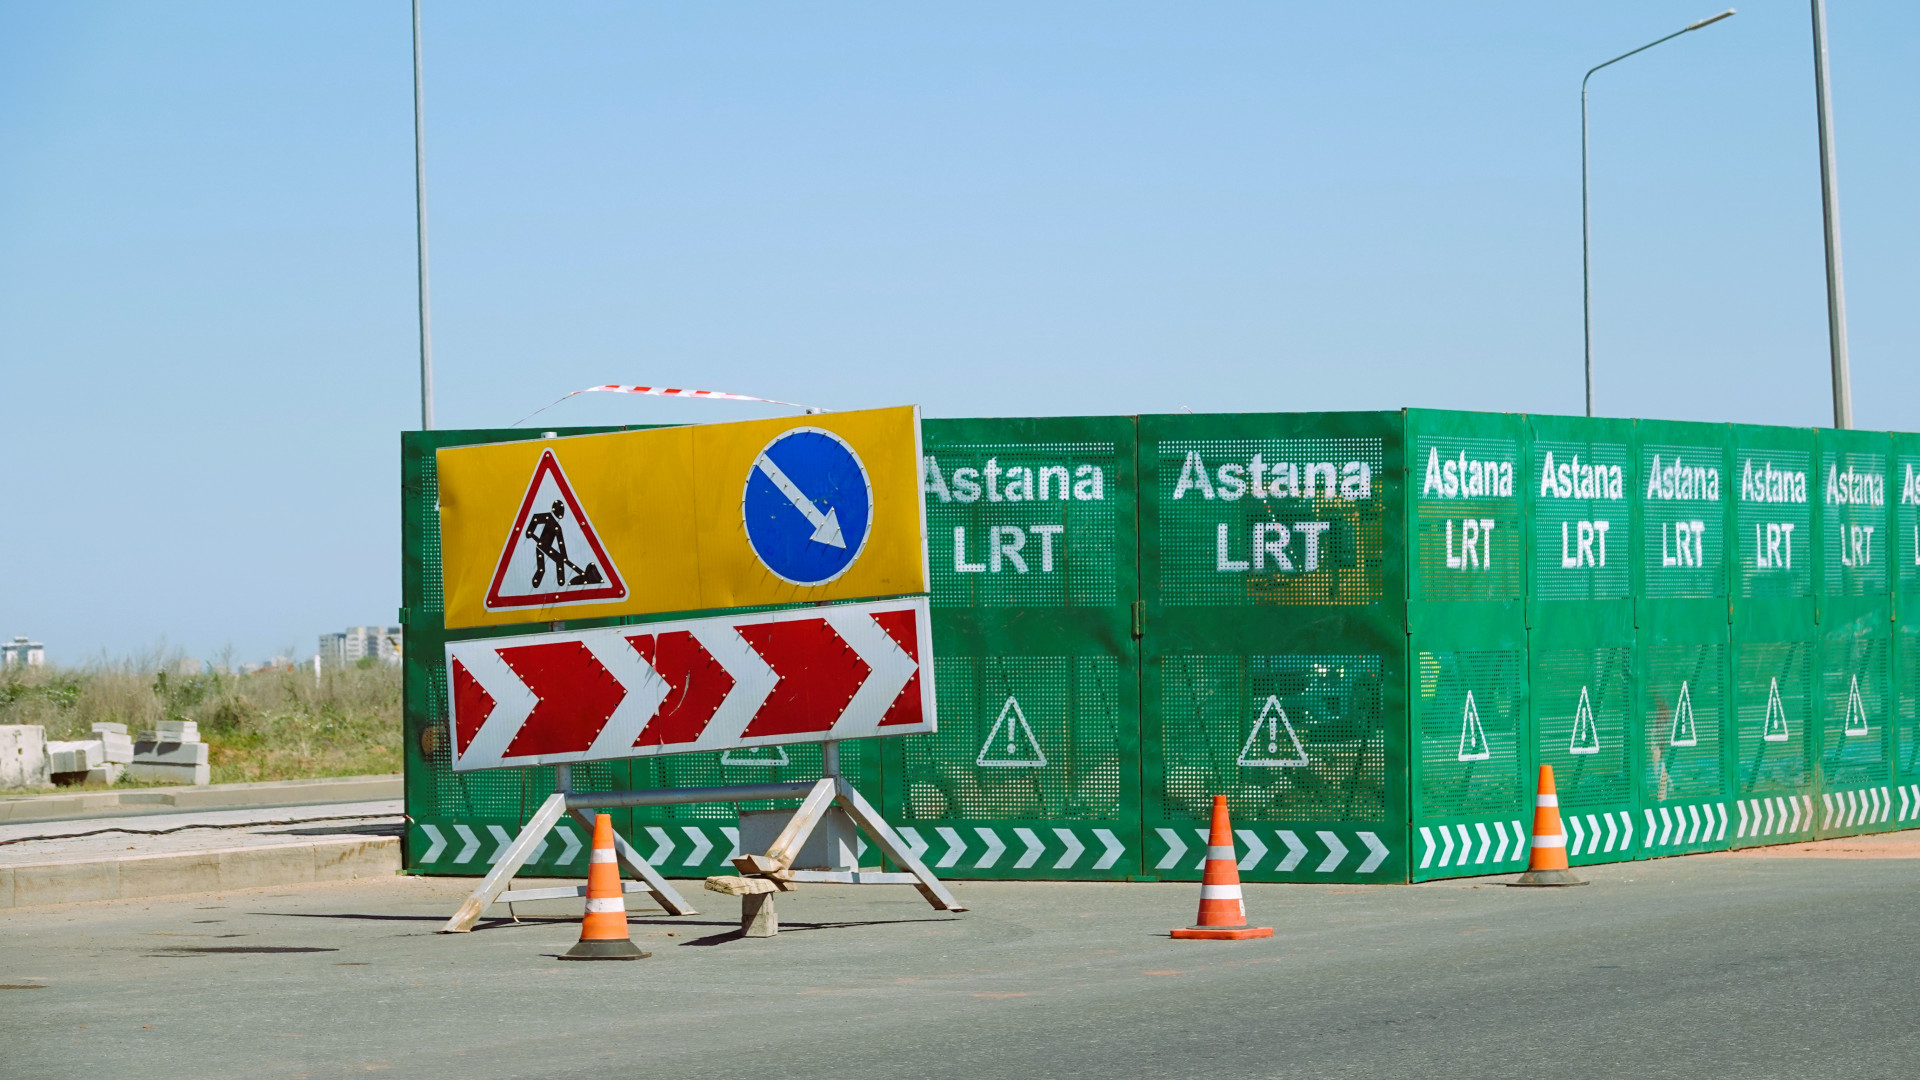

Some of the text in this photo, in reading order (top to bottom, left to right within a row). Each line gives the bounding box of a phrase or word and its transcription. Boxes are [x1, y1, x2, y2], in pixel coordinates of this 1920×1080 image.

[1173, 449, 1372, 501] Astana
[1424, 446, 1514, 499] Astana
[1540, 451, 1624, 500] Astana
[1646, 454, 1719, 501] Astana
[1741, 458, 1806, 504] Astana
[1826, 461, 1884, 506] Astana
[953, 524, 1064, 575] LRT
[1216, 521, 1330, 573] LRT
[1445, 519, 1495, 571] LRT
[1561, 520, 1610, 569] LRT
[1661, 521, 1706, 569] LRT
[1756, 523, 1795, 570] LRT
[1840, 524, 1875, 567] LRT
